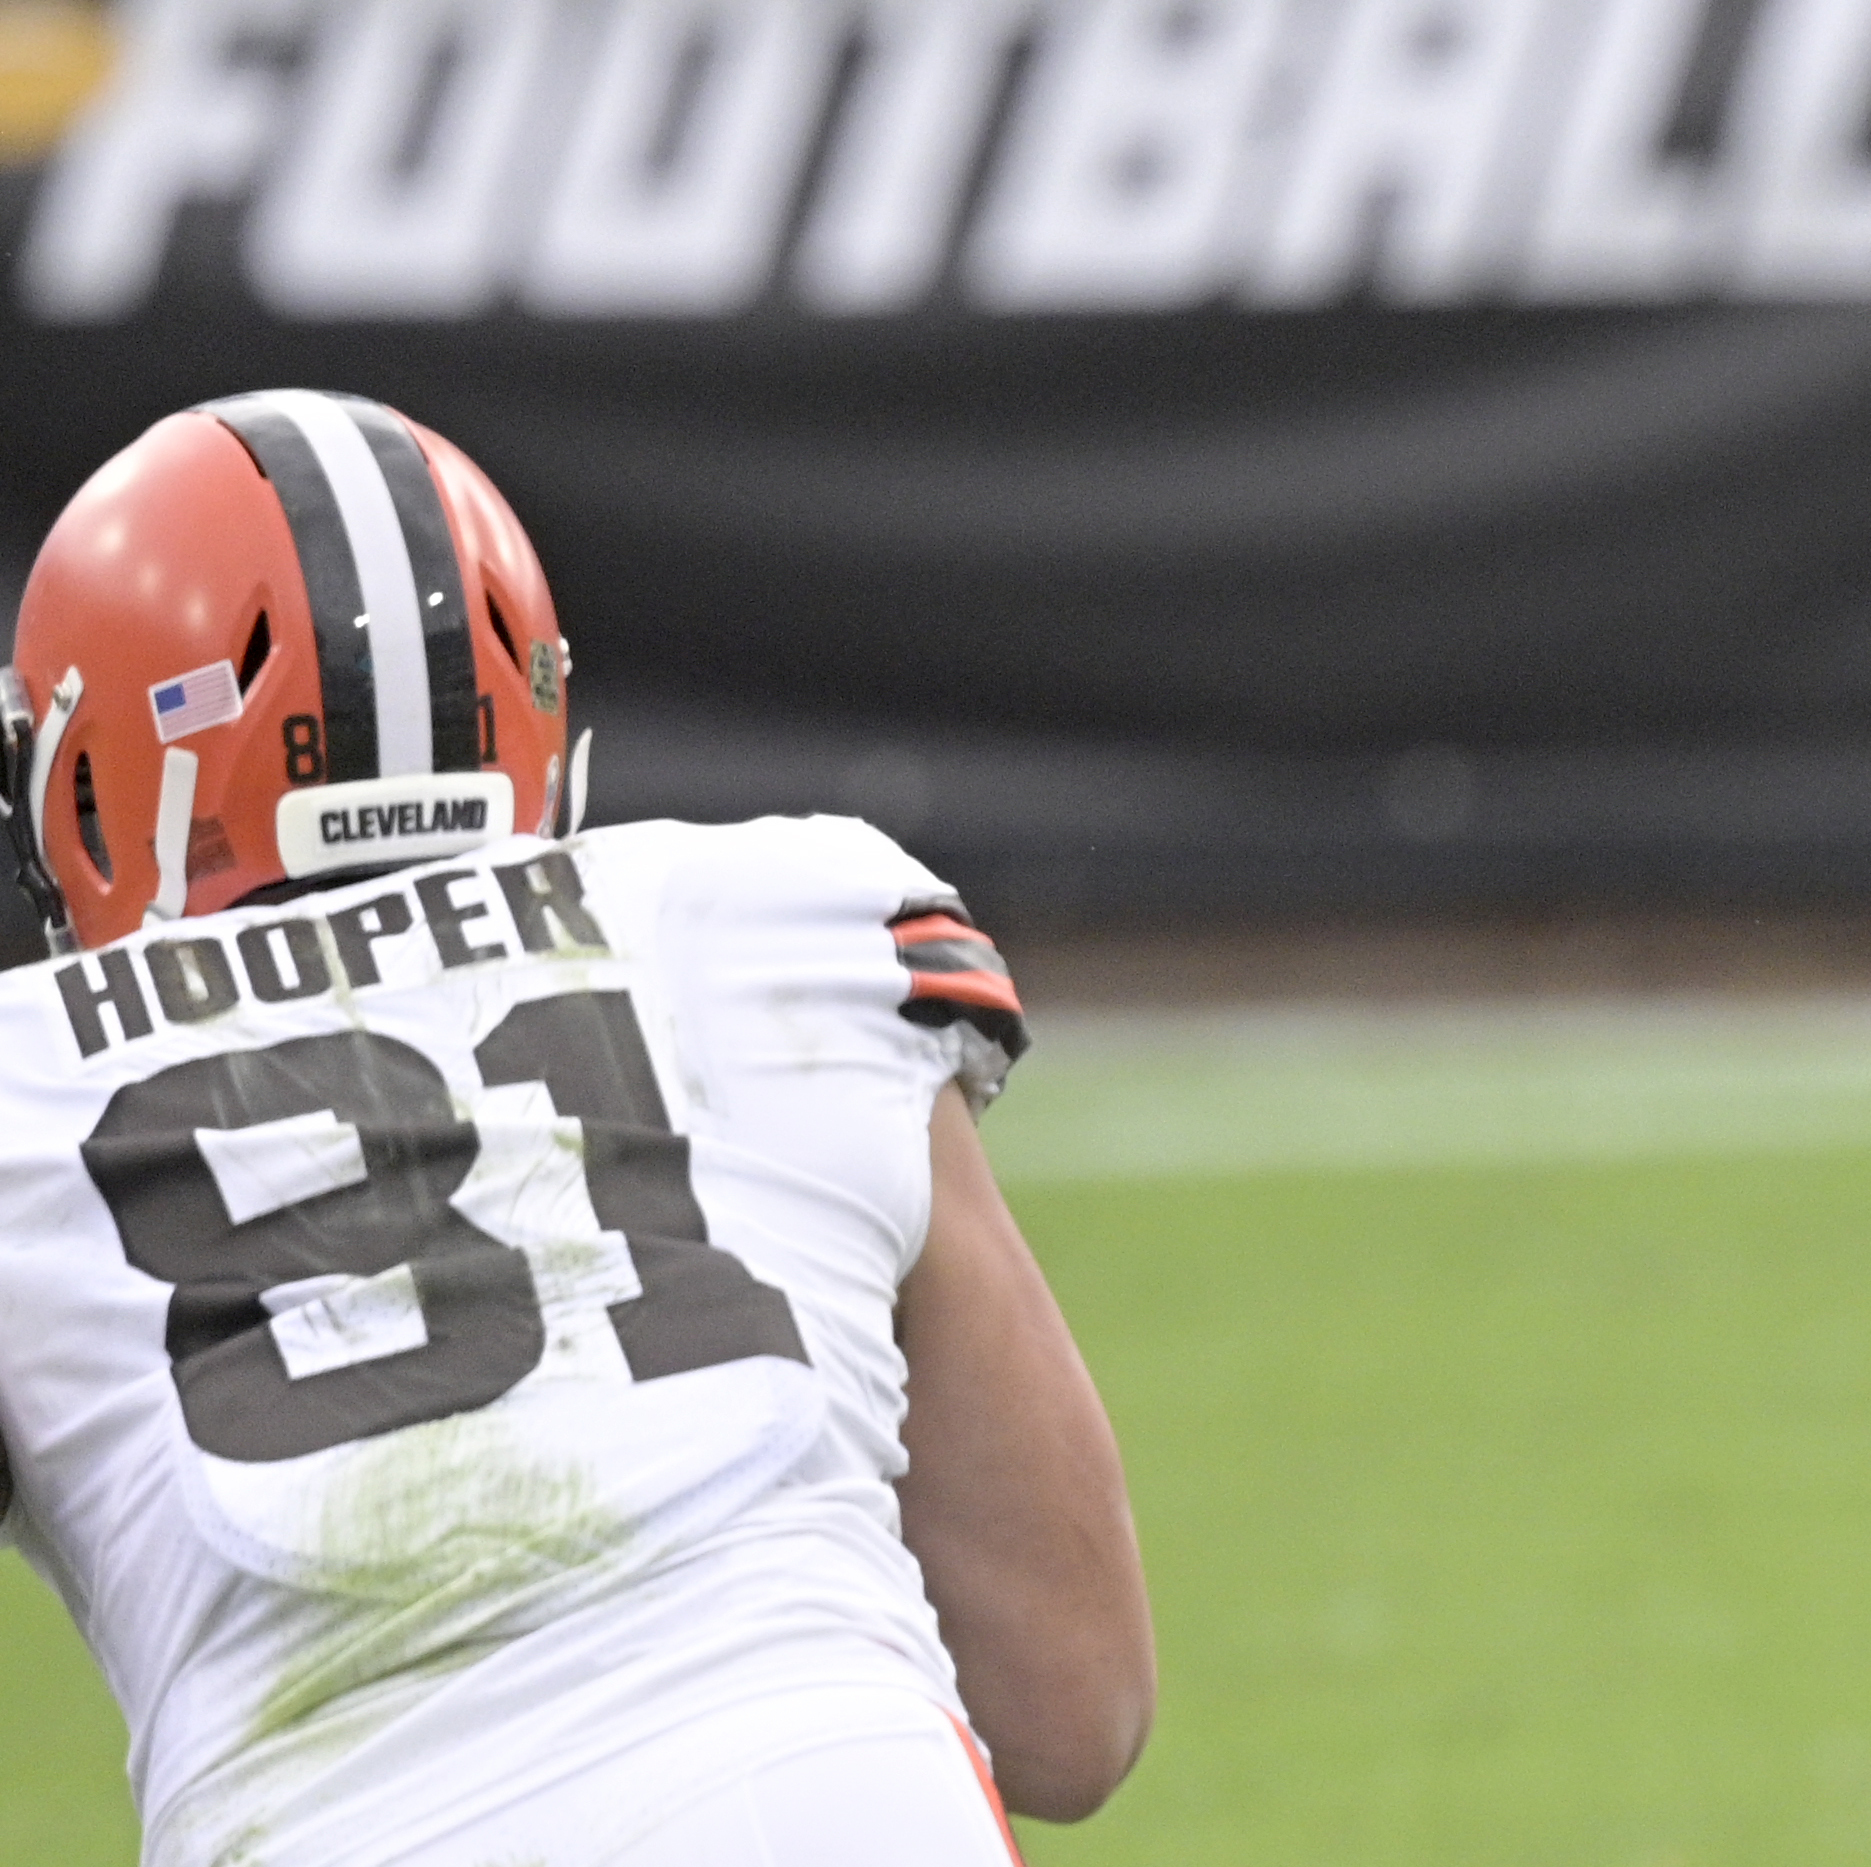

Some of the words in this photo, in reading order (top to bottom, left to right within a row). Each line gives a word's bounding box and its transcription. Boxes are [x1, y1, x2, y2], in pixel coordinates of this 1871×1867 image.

[320, 797, 489, 844] CLEVELAND
[54, 850, 612, 1060] HOOPER
[80, 988, 812, 1464] 81
